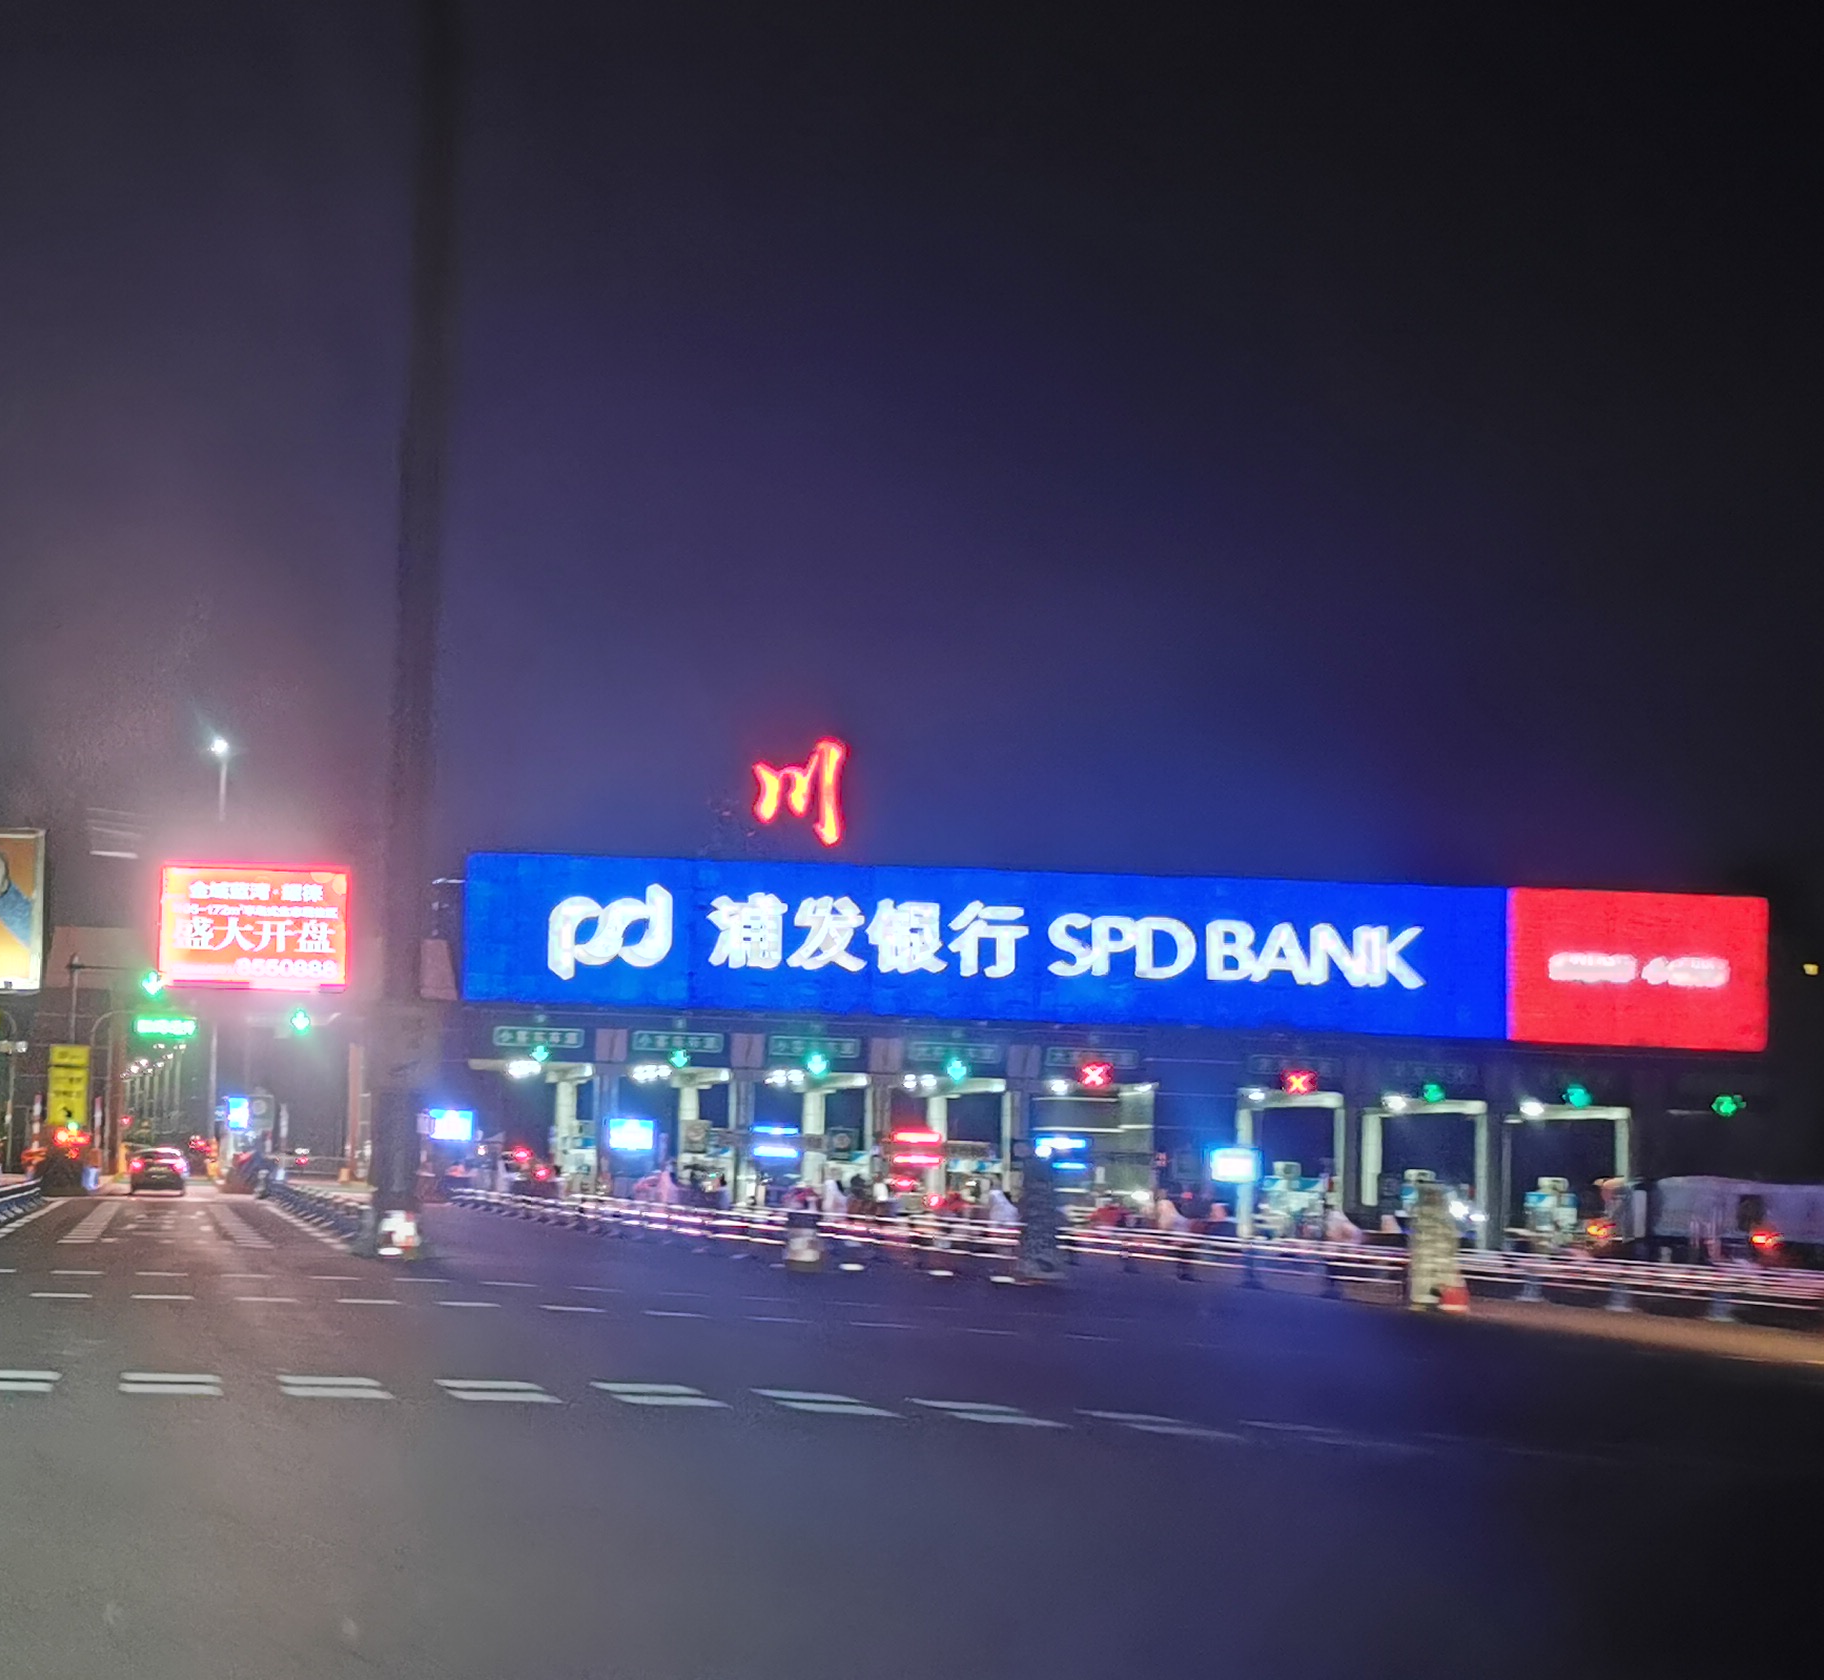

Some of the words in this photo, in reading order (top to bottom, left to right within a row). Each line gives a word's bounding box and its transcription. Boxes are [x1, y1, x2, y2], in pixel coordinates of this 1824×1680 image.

[752, 734, 848, 845] 川
[177, 916, 336, 953] 盛大开盘
[707, 892, 1029, 979] 浦发银行
[1047, 912, 1197, 980] SPD
[1206, 918, 1426, 989] BANK
